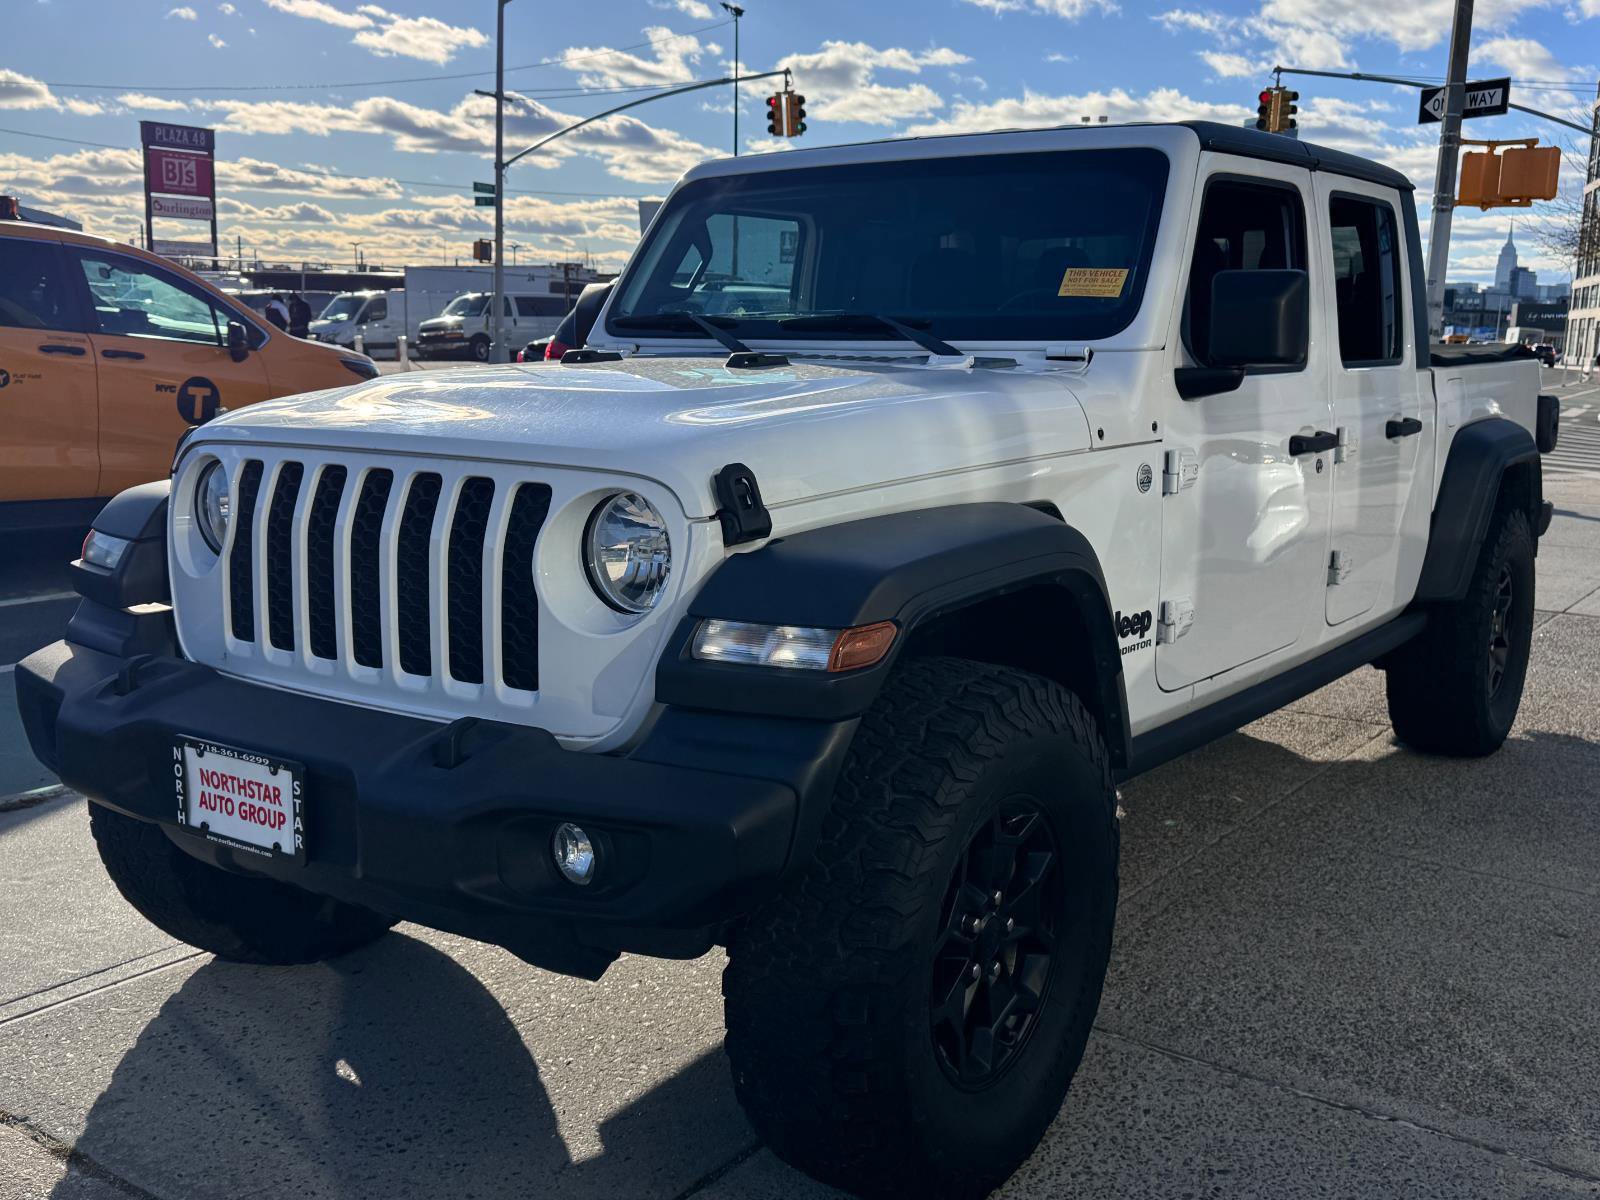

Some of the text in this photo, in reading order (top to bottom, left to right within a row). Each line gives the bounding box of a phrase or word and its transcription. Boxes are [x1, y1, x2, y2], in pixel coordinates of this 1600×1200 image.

[1469, 91, 1497, 107] WAY
[155, 127, 206, 146] PLAZA 48
[152, 200, 211, 217] Burlington
[155, 383, 177, 393] NYC
[1114, 610, 1152, 639] Jeep
[1120, 639, 1152, 656] DIATOR
[199, 743, 270, 766] 718-361-6299
[173, 746, 186, 825] NORTH
[199, 767, 283, 807] NORTHSTAR
[199, 790, 287, 831] AUTO GROUP
[293, 780, 304, 849] STAR
